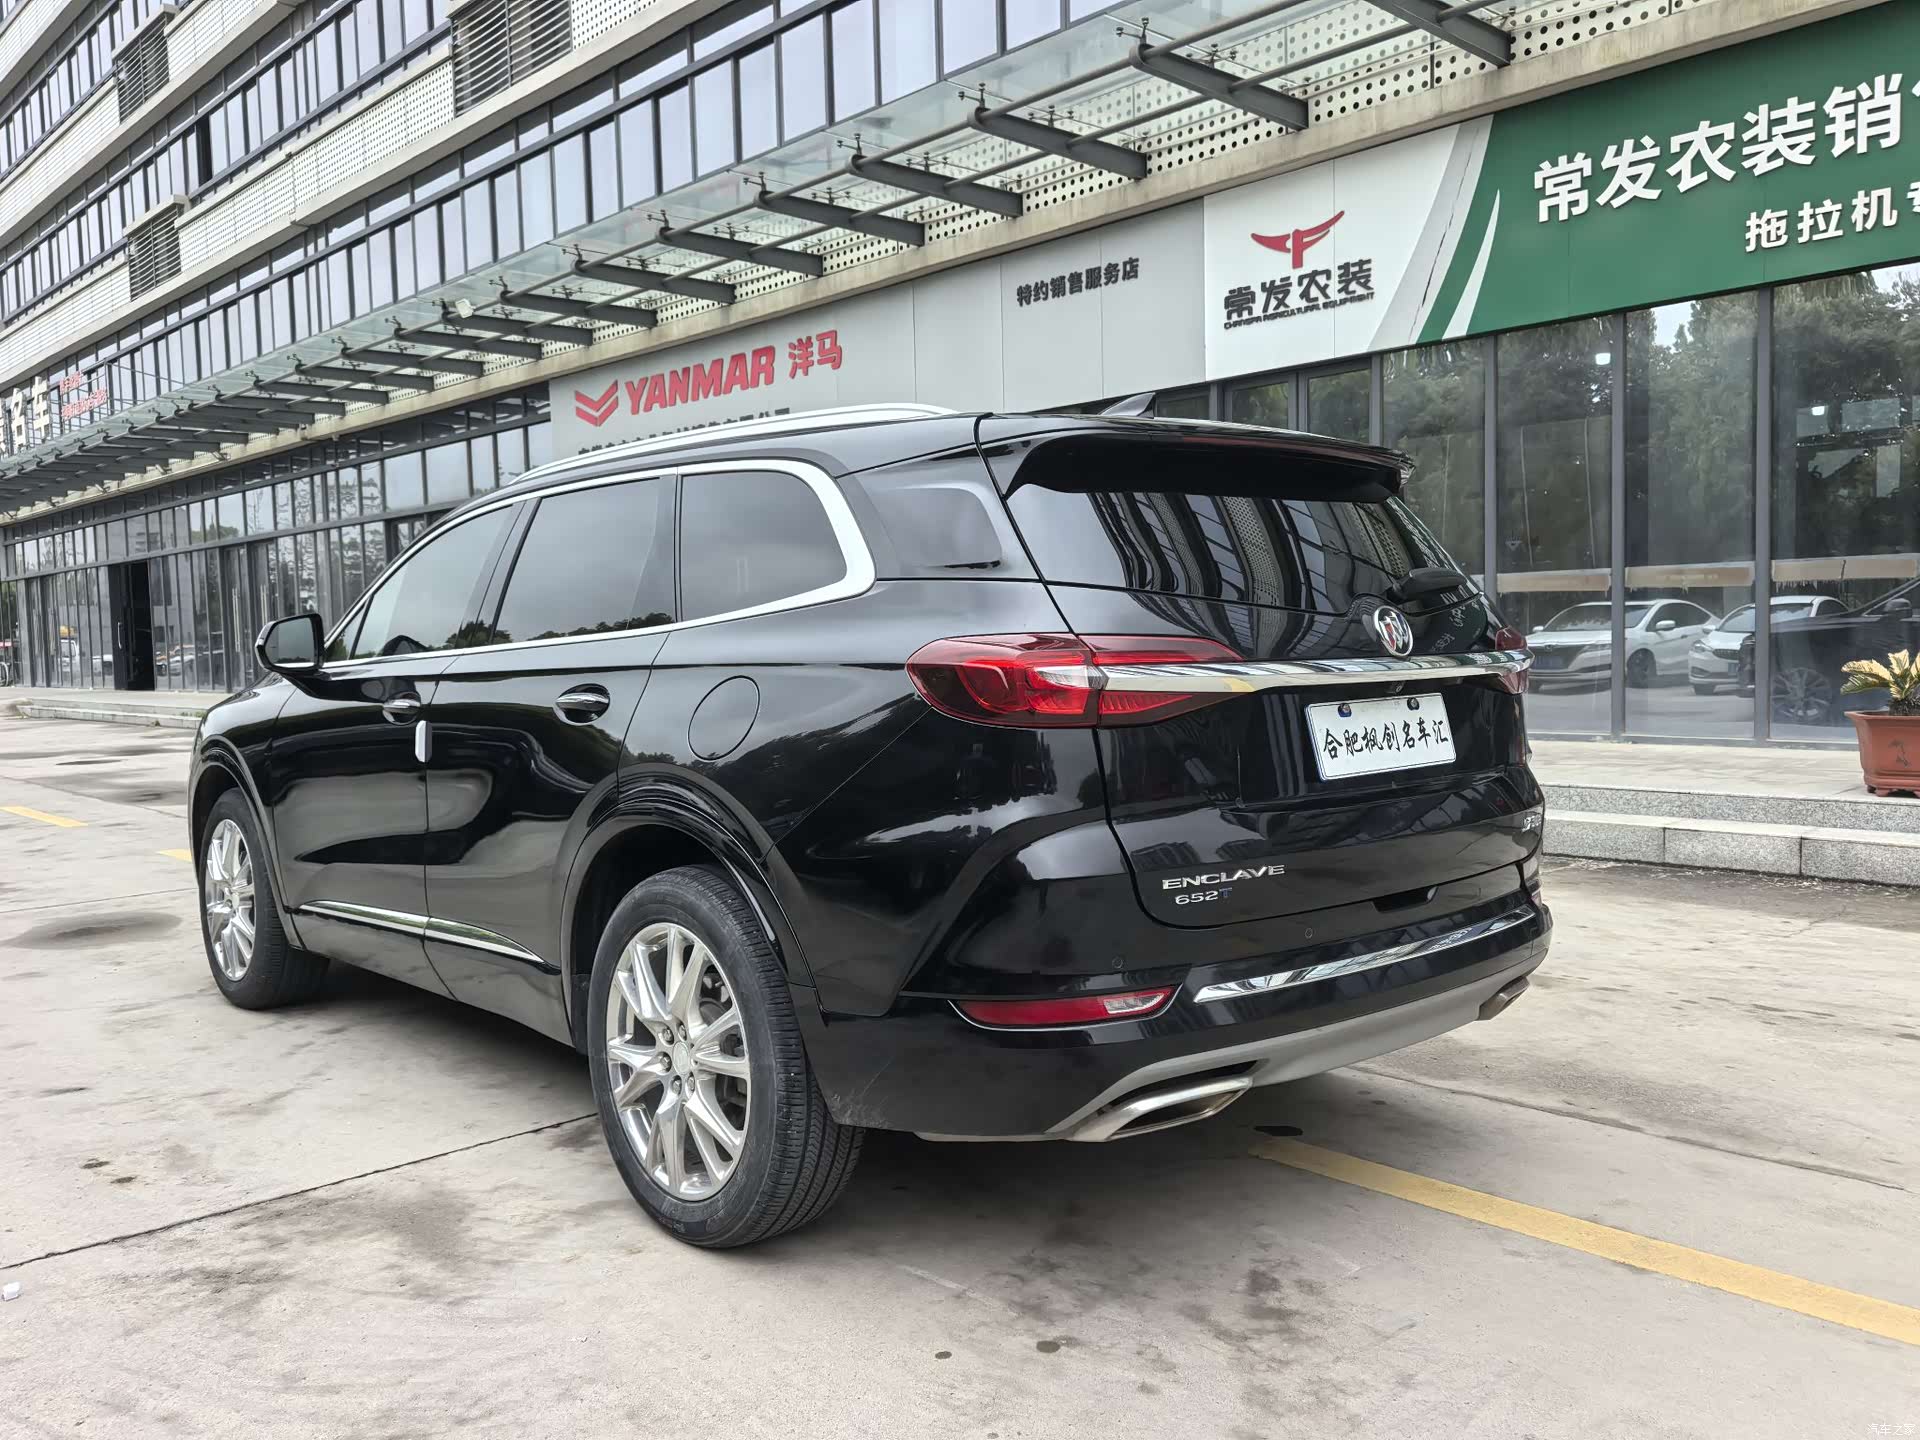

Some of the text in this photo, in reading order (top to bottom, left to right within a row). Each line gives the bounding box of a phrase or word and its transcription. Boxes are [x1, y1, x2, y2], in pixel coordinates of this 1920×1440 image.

[1534, 73, 1920, 223] 常发农装销
[1745, 181, 1920, 253] 拖拉机
[1017, 257, 1139, 307] 特约销售服务店
[1224, 258, 1375, 321] 常发农装
[625, 329, 842, 415] YANMAR 洋马
[1323, 716, 1449, 760] 合肥枫创名车汇
[1162, 865, 1285, 889] ENCLAVE
[1175, 887, 1232, 905] 652T
